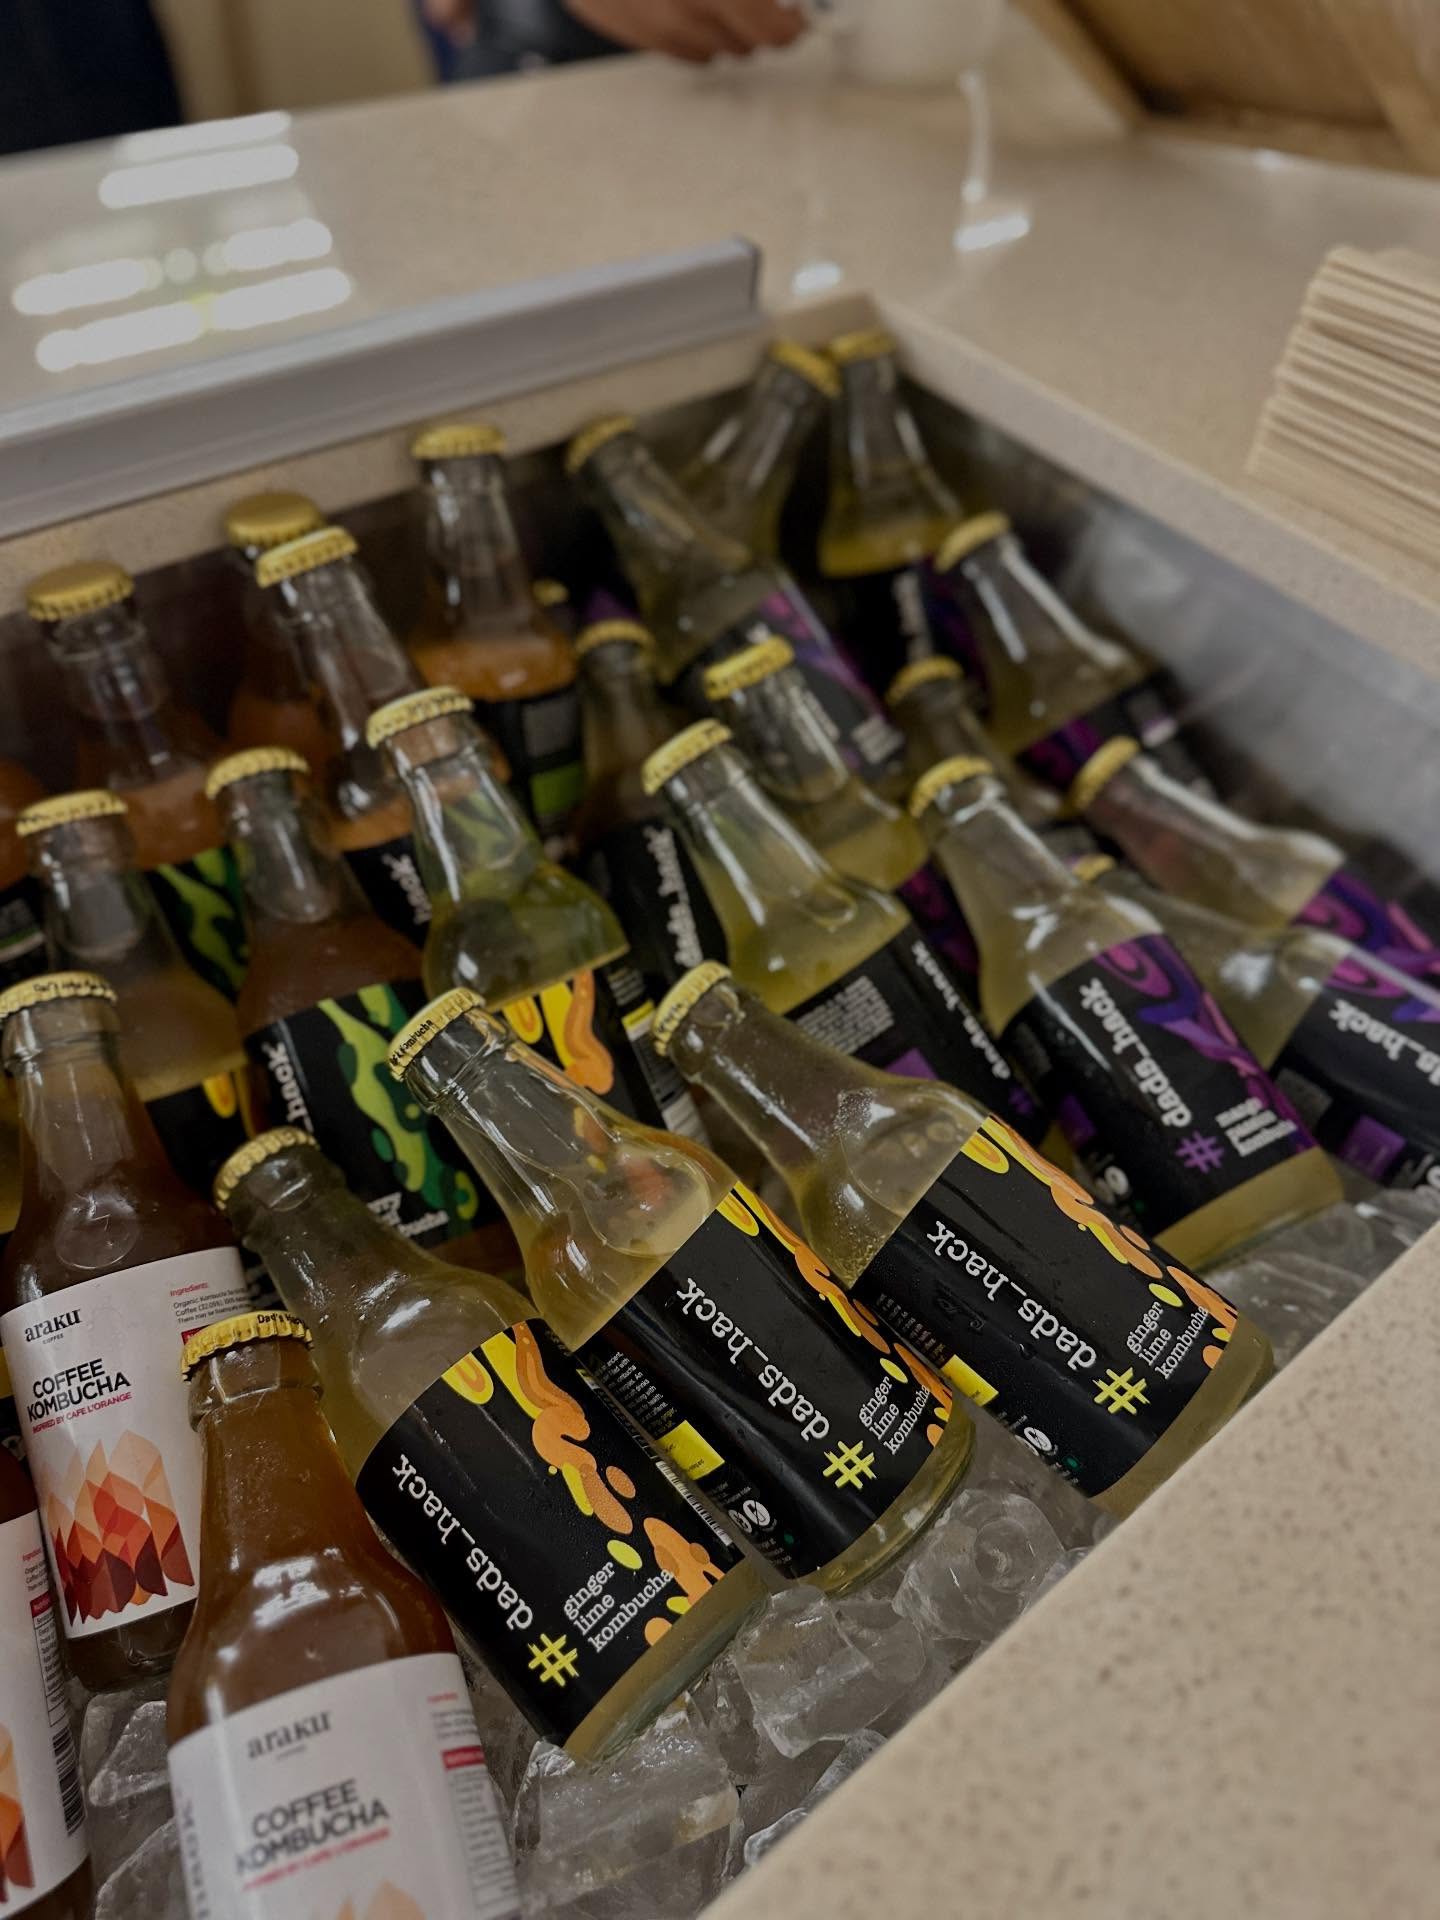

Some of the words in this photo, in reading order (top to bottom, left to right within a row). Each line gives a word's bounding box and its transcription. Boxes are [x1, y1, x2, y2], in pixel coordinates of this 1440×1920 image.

[1328, 998, 1440, 1087] s_hack
[25, 1309, 83, 1342] araku
[173, 1298, 199, 1309] Organic
[175, 1307, 198, 1318] Coffee
[258, 1313, 283, 1324] Dad's
[1126, 1301, 1164, 1355] ginger
[1138, 1327, 1173, 1366] lime
[1155, 1306, 1210, 1380] kombucha
[27, 1372, 131, 1422] KOMBUCHA
[33, 1358, 105, 1398] COFFEE
[859, 1376, 893, 1425] ginger
[56, 1416, 65, 1425] BY
[66, 1409, 87, 1420] CAFE
[87, 1392, 132, 1413] L'ORANGE
[869, 1402, 900, 1440] lime
[883, 1384, 930, 1456] kombucha
[563, 1561, 615, 1619] ginger
[573, 1592, 615, 1635] lime
[587, 1568, 676, 1653] kombucha
[248, 1710, 332, 1759] araku
[252, 1778, 360, 1838] COFFEE
[236, 1799, 390, 1876] KOMBUCHA
